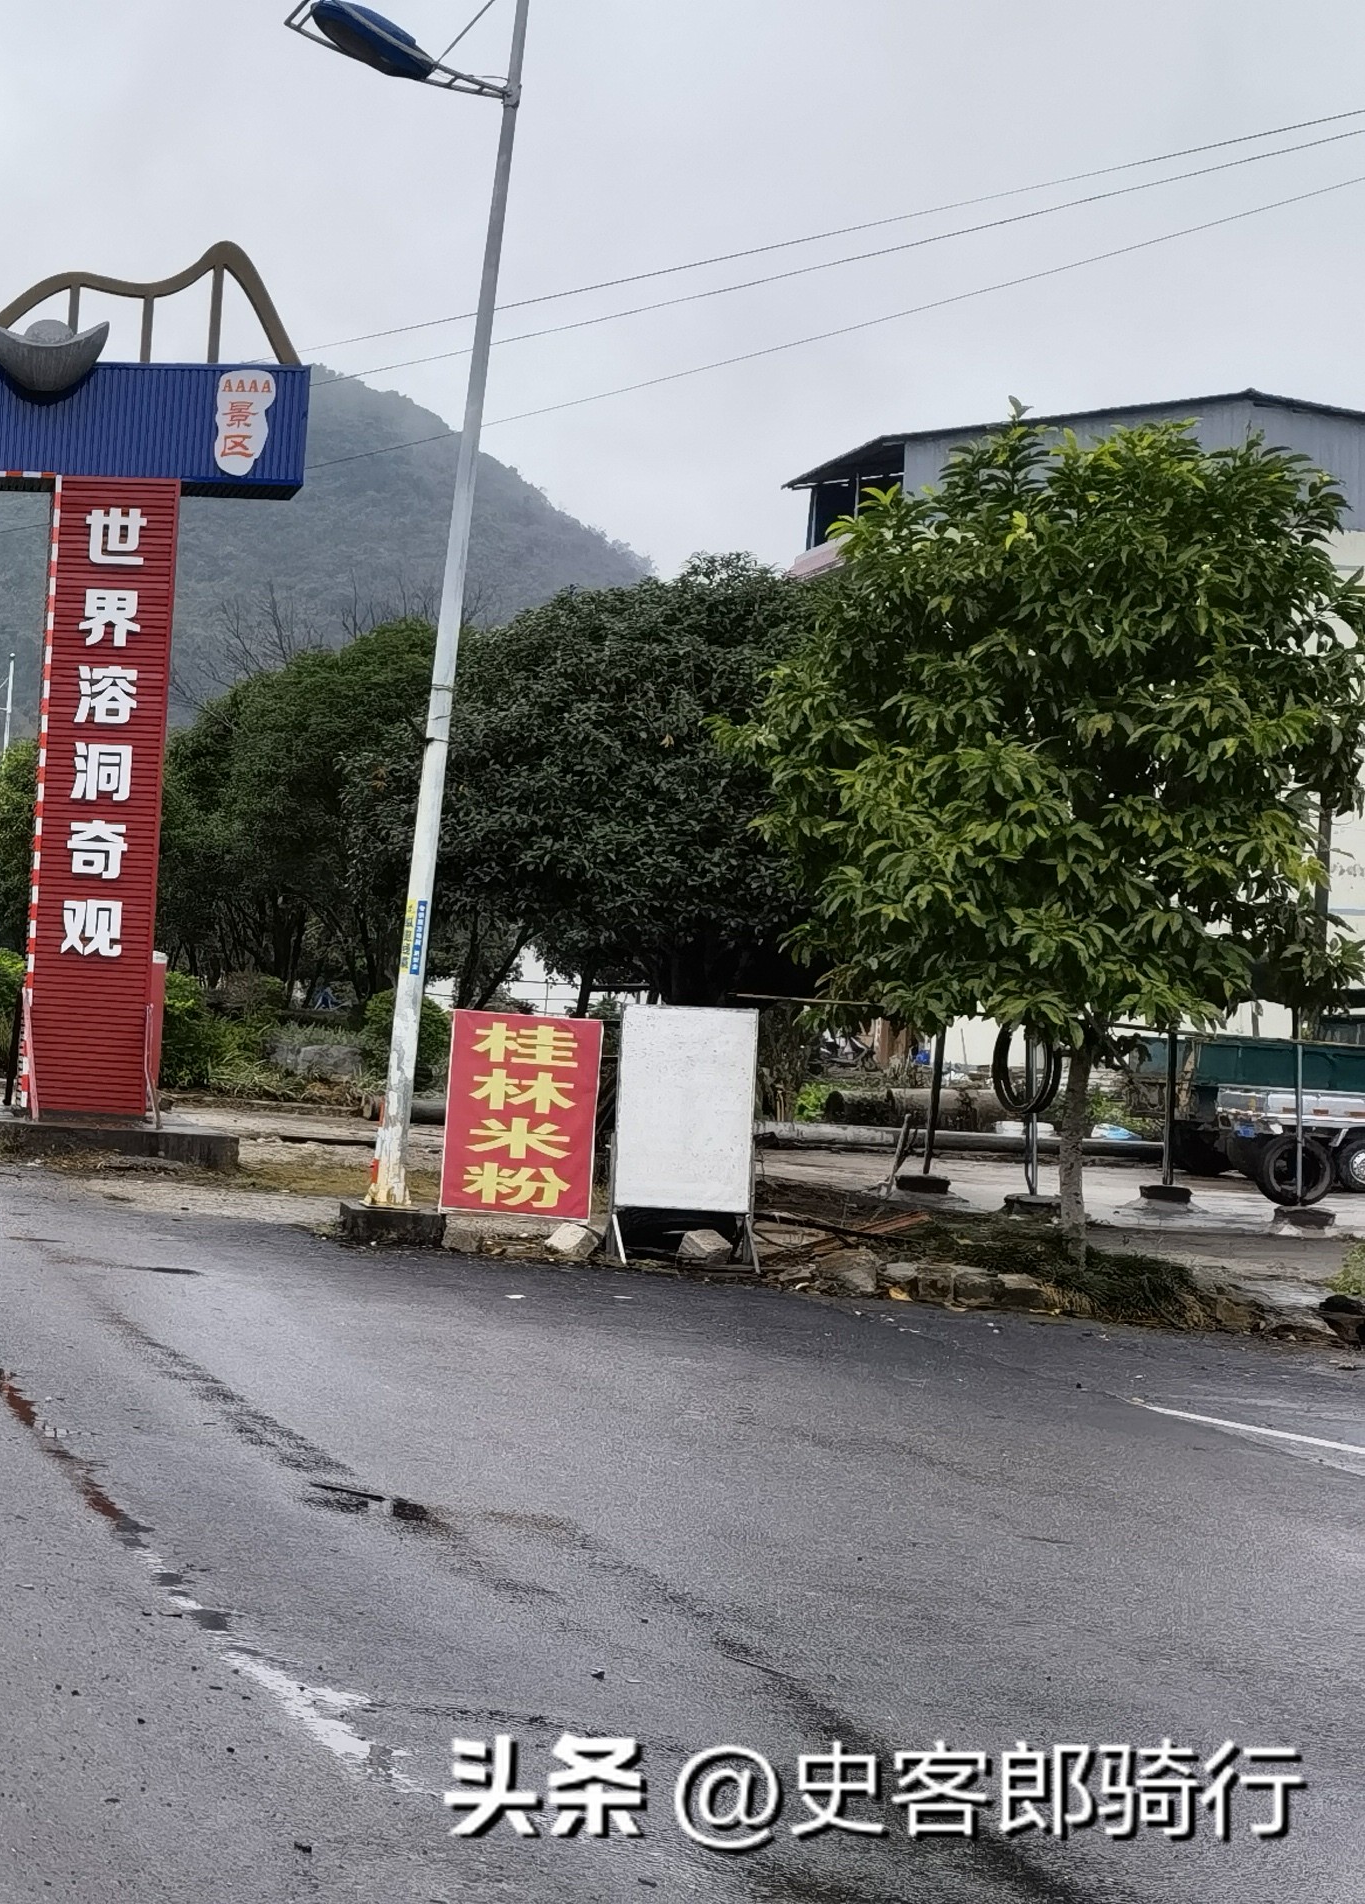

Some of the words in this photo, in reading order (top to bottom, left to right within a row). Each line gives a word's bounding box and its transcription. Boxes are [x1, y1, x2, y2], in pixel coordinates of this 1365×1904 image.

[221, 401, 259, 458] 景区
[222, 379, 272, 392] AAAA
[60, 507, 148, 958] 世界溶洞奇观
[463, 1022, 579, 1209] 桂林米粉
